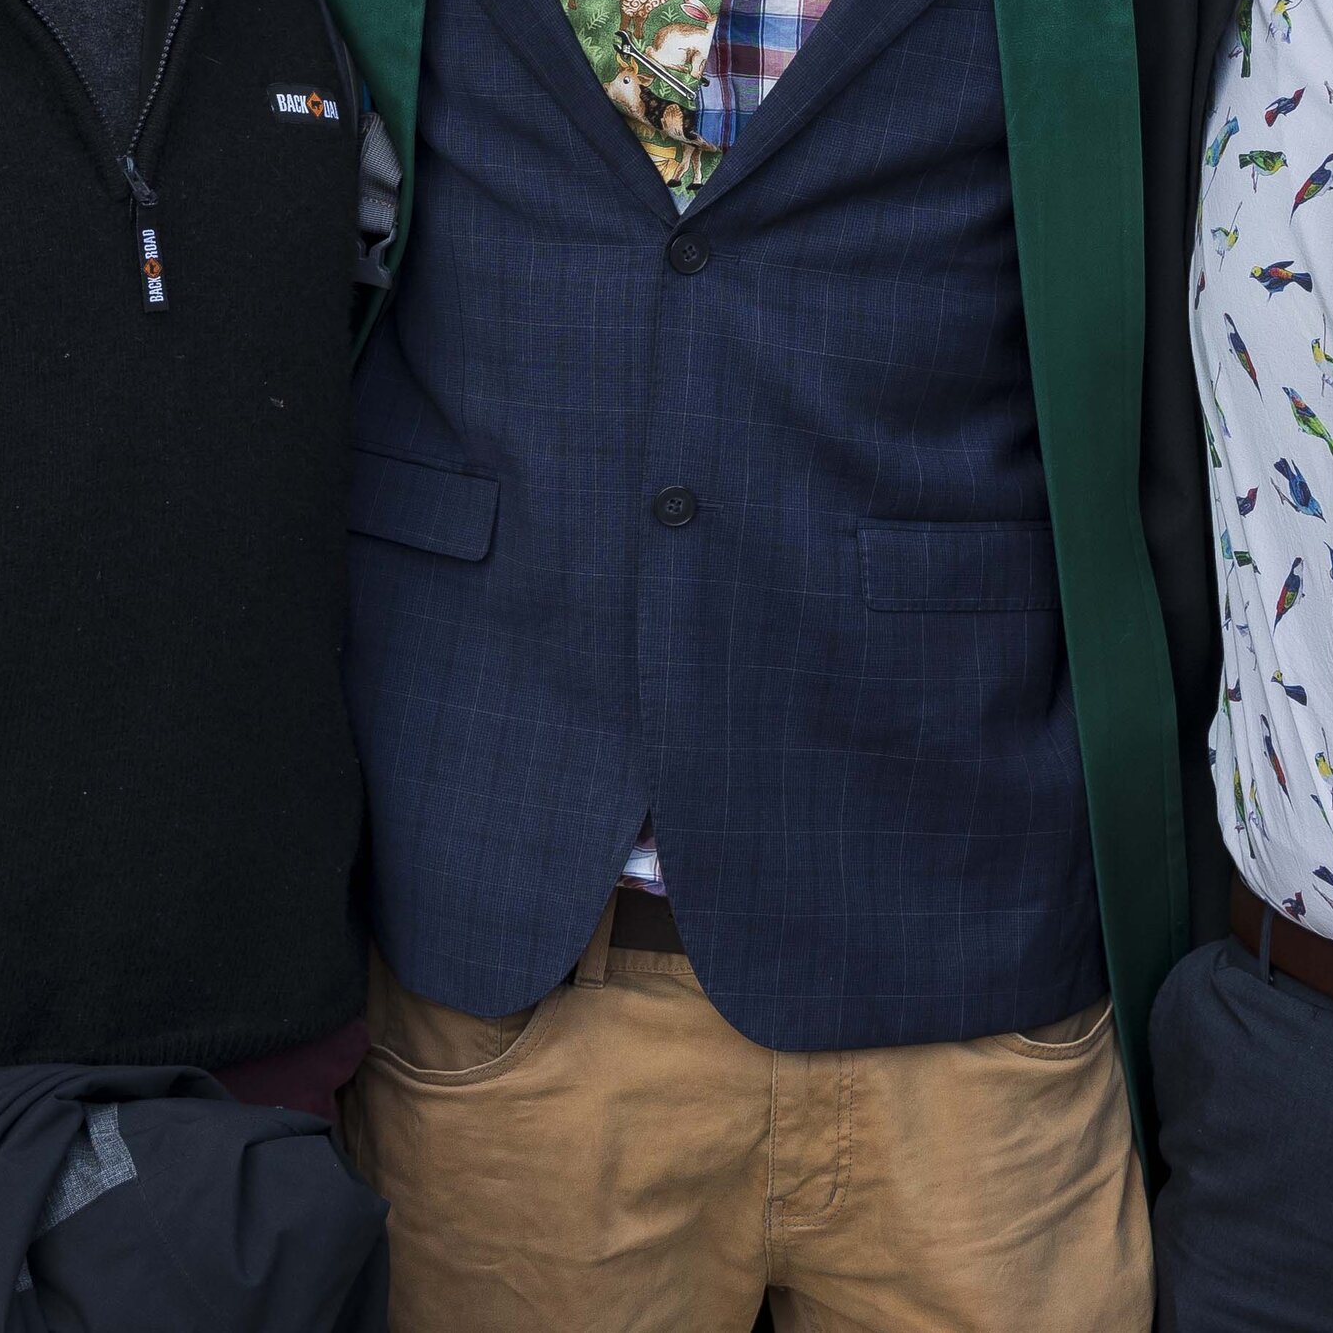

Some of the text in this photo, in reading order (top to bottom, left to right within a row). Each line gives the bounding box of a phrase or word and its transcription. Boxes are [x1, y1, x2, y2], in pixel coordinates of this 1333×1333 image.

[276, 93, 309, 114] BACK
[142, 229, 165, 303] BACK ROAD
